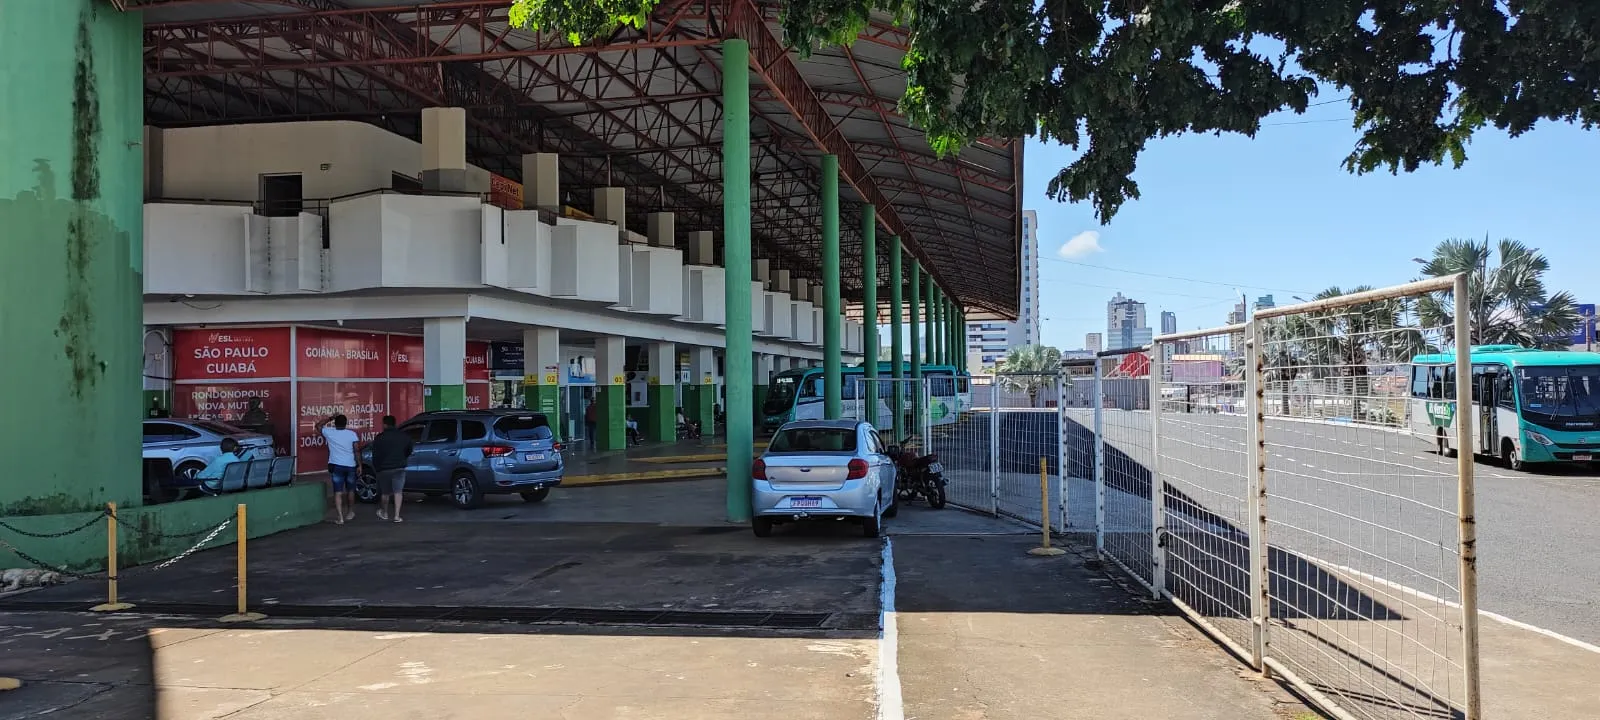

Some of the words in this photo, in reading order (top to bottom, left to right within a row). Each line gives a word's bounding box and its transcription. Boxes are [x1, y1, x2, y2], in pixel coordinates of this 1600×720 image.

[218, 335, 233, 343] ESL
[194, 346, 221, 359] SÃO
[224, 346, 269, 358] PAULO
[305, 345, 340, 358] GOIÂNIA
[346, 348, 379, 360] BRASÍLIA
[398, 354, 409, 363] ESL
[206, 360, 257, 374] CUIABÁ
[546, 375, 556, 383] 02
[191, 389, 270, 400] RONDONÓPOLIS
[198, 402, 226, 411] NOVA
[227, 401, 264, 410] MUTM
[300, 404, 345, 417] SALVADOR
[349, 403, 384, 415] ARACAJU
[300, 434, 324, 448] JOÃO
